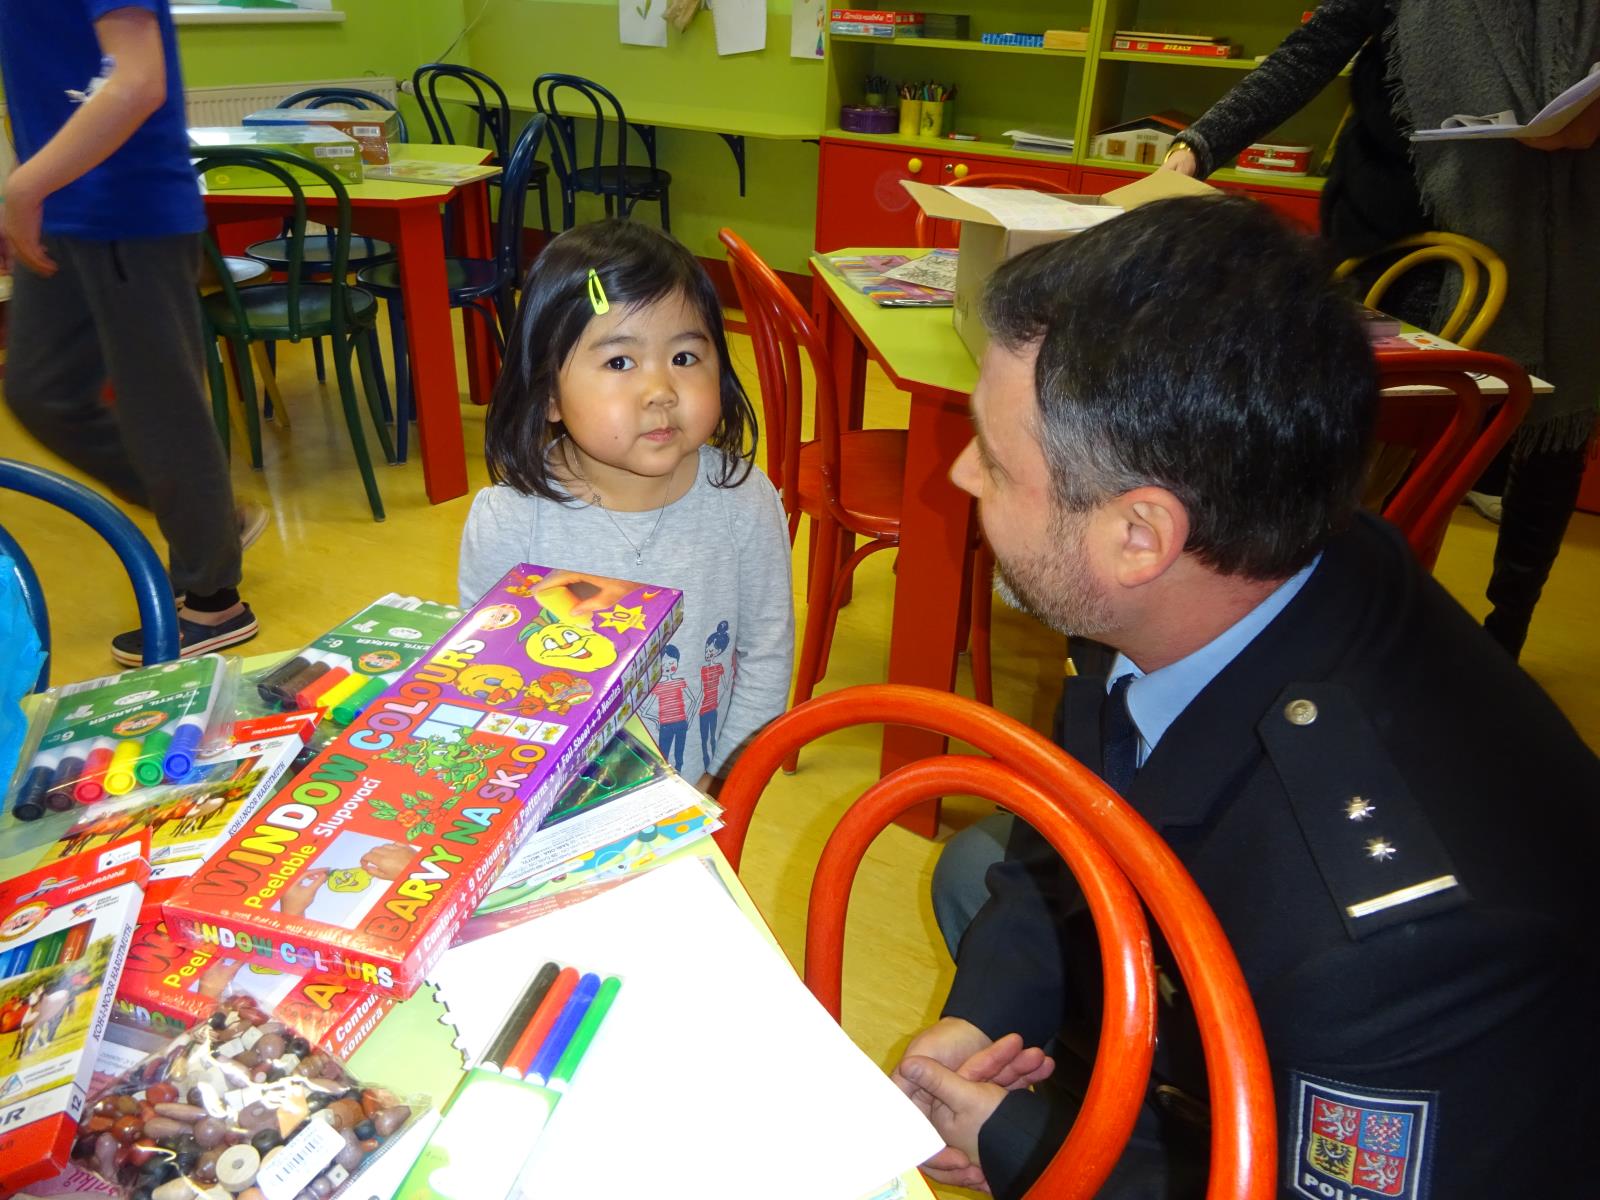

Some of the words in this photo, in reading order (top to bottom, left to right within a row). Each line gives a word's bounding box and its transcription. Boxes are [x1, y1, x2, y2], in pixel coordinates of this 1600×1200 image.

[610, 611, 632, 623] 10
[192, 753, 368, 897] WINDOW
[348, 638, 487, 751] COLOURS
[228, 797, 258, 838] KOH-I-NOOR
[256, 760, 286, 800] HARDTMUTH
[244, 844, 317, 909] Peelable
[313, 776, 382, 838] Slupovací
[364, 844, 464, 942] BARVY
[441, 807, 503, 845] NA
[478, 744, 547, 804] SKLO
[424, 902, 458, 951] Contour
[475, 841, 505, 882] Colours
[519, 781, 549, 824] Patterns
[92, 981, 116, 1042] KOH-I-NOOR
[110, 923, 133, 982] HARDTMUTH
[162, 949, 213, 989] Peel
[280, 942, 394, 989] COLOURS
[340, 1007, 384, 1060] kontura
[71, 1095, 83, 1112] 12
